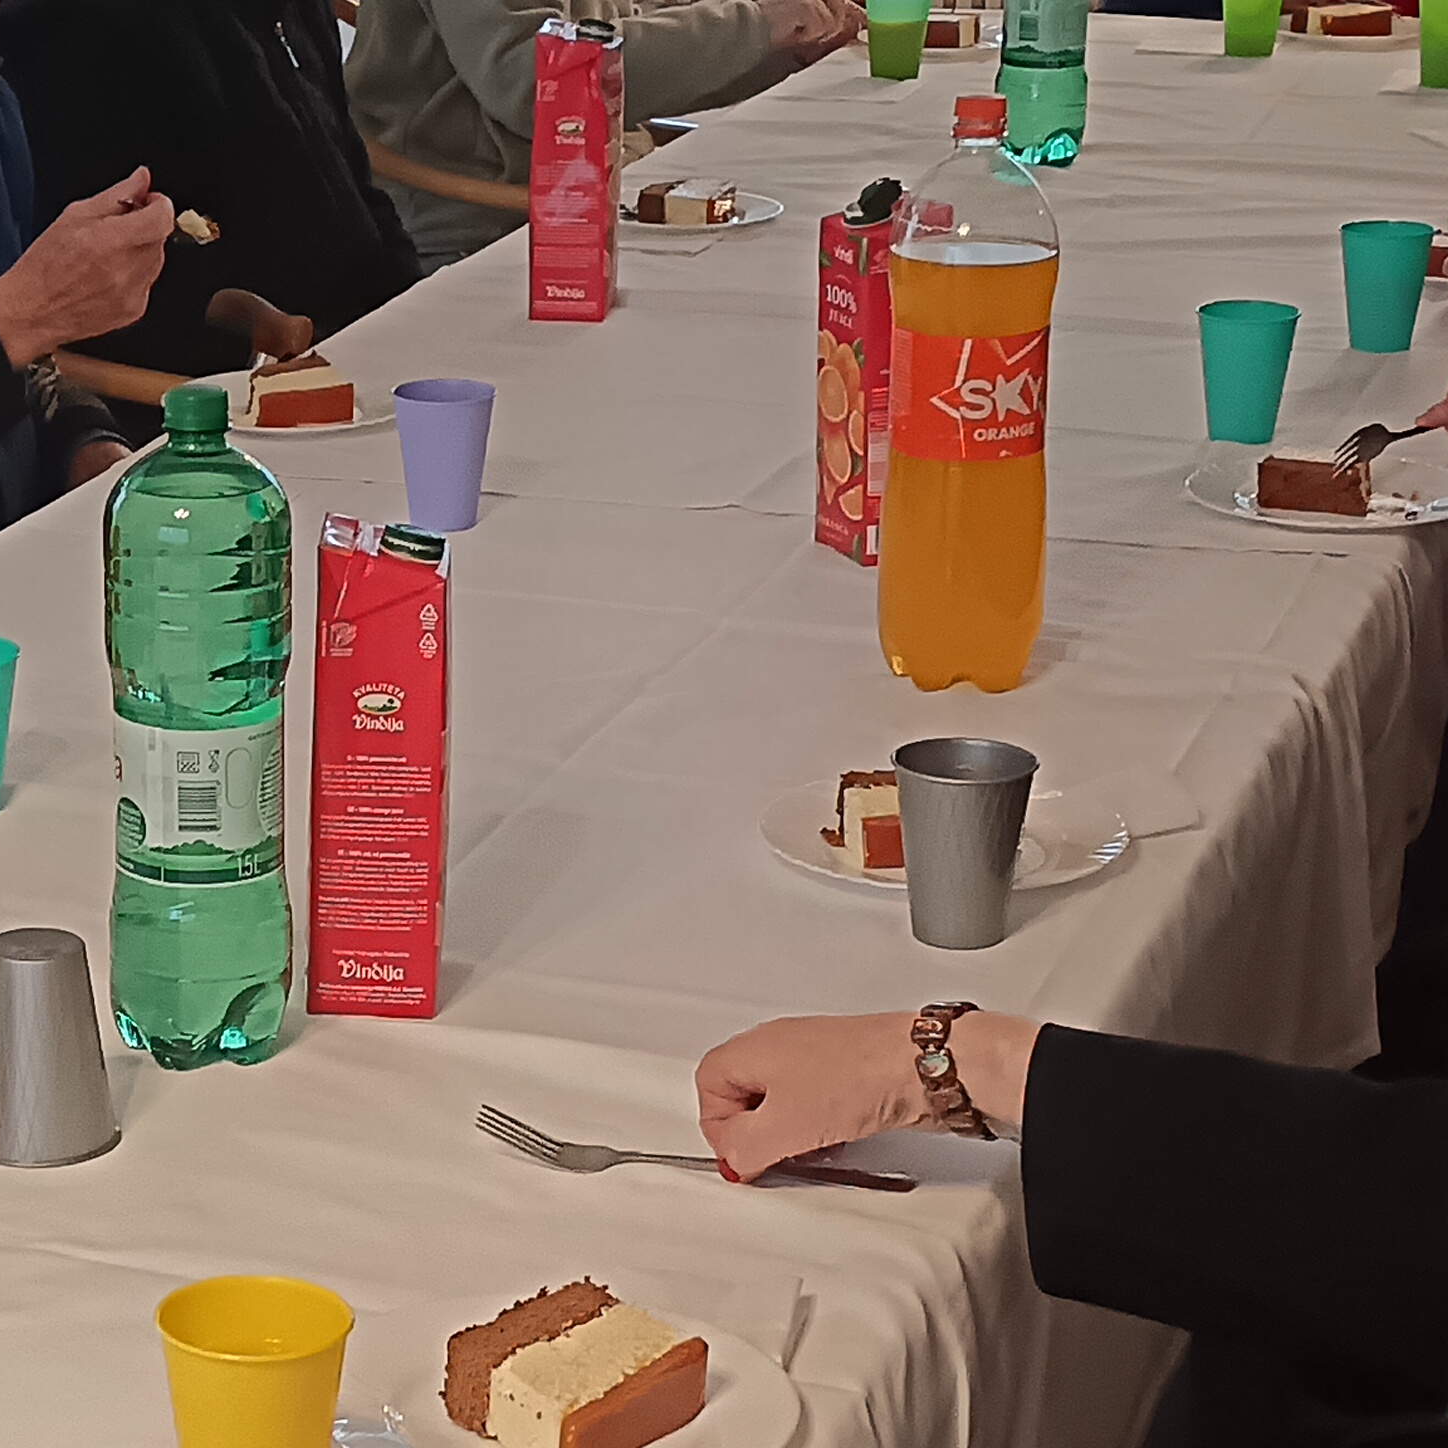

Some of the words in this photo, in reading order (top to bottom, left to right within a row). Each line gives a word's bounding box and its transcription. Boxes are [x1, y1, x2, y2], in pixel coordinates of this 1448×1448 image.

[826, 283, 857, 314] 100%
[959, 368, 1043, 422] SKY
[973, 421, 1036, 442] ORANGE
[352, 682, 405, 700] KVALITETA
[352, 713, 404, 732] Vindija
[337, 959, 404, 982] Vindija
